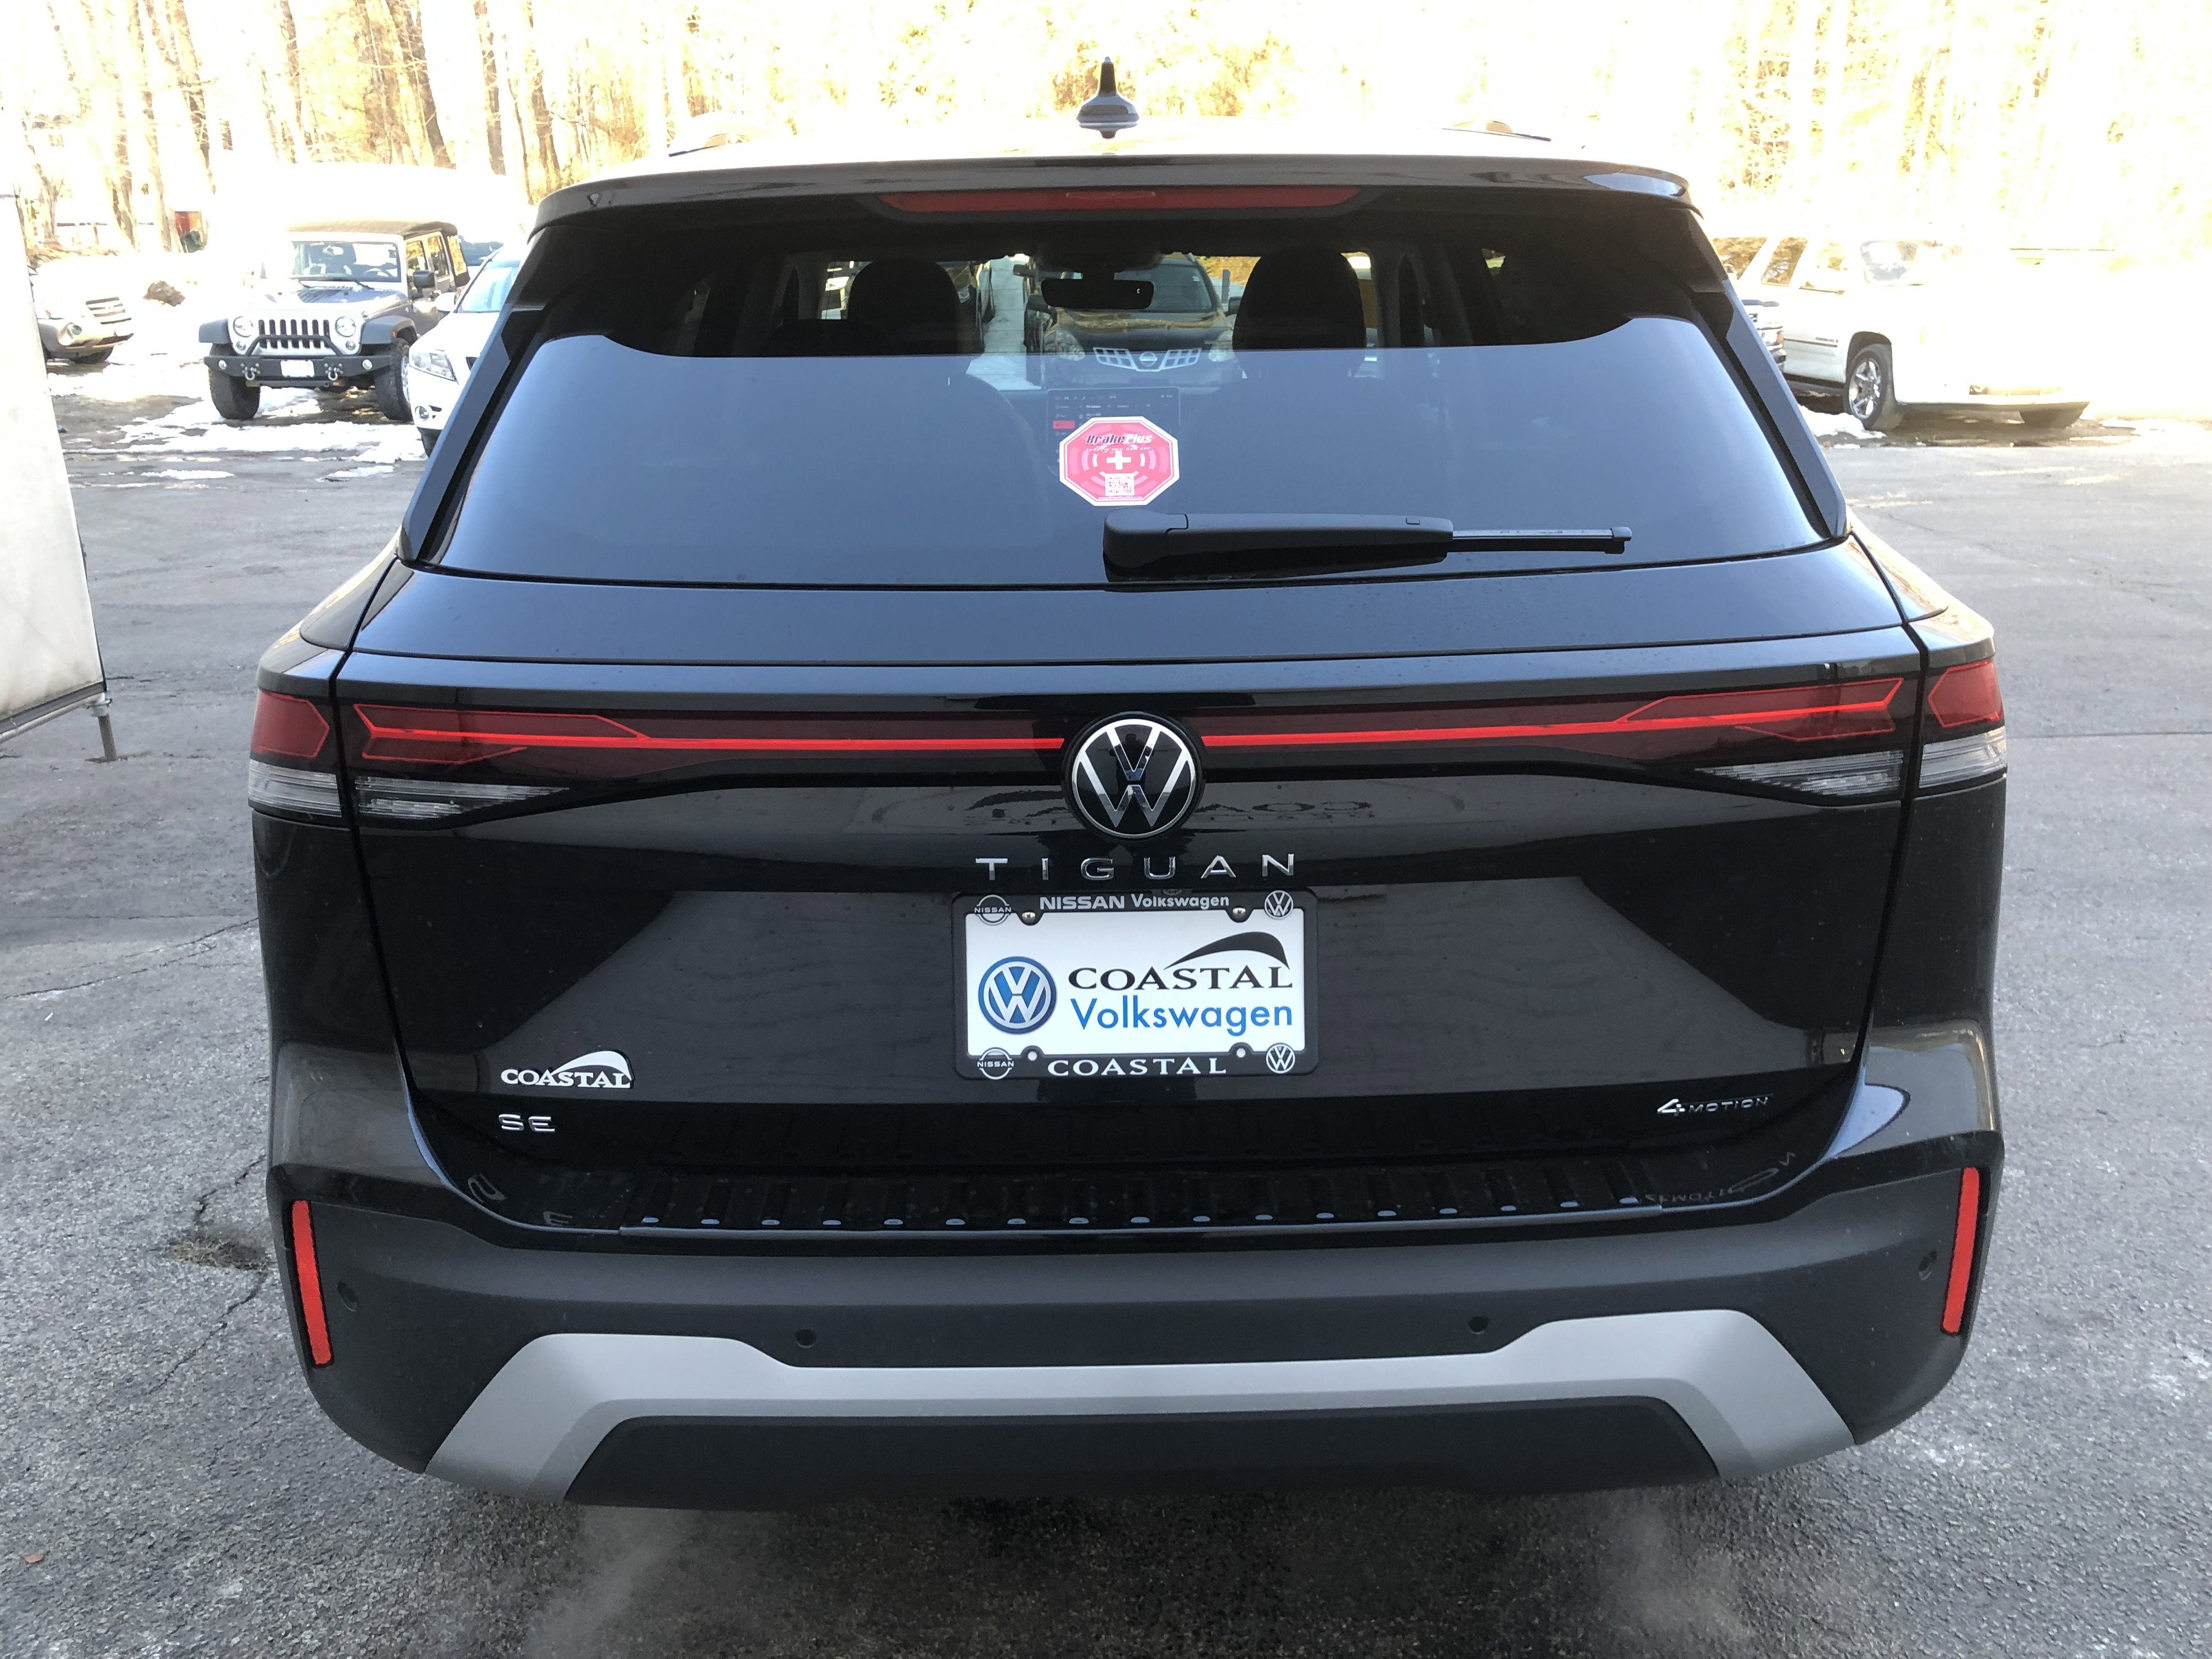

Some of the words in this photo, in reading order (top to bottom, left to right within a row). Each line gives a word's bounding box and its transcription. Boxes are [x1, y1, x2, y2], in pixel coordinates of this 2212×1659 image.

[975, 854, 1295, 881] TIGUAN
[974, 906, 1012, 914] NISSAN
[1040, 895, 1125, 910] NISSAN
[1131, 893, 1230, 911] Volkswagen
[1068, 966, 1293, 991] COASTAL
[1070, 995, 1293, 1037] Volkswagen
[977, 1060, 1015, 1068] NISSAN
[1047, 1057, 1227, 1076] COASTAL
[500, 1069, 631, 1089] COASTAL
[498, 1113, 556, 1133] SE
